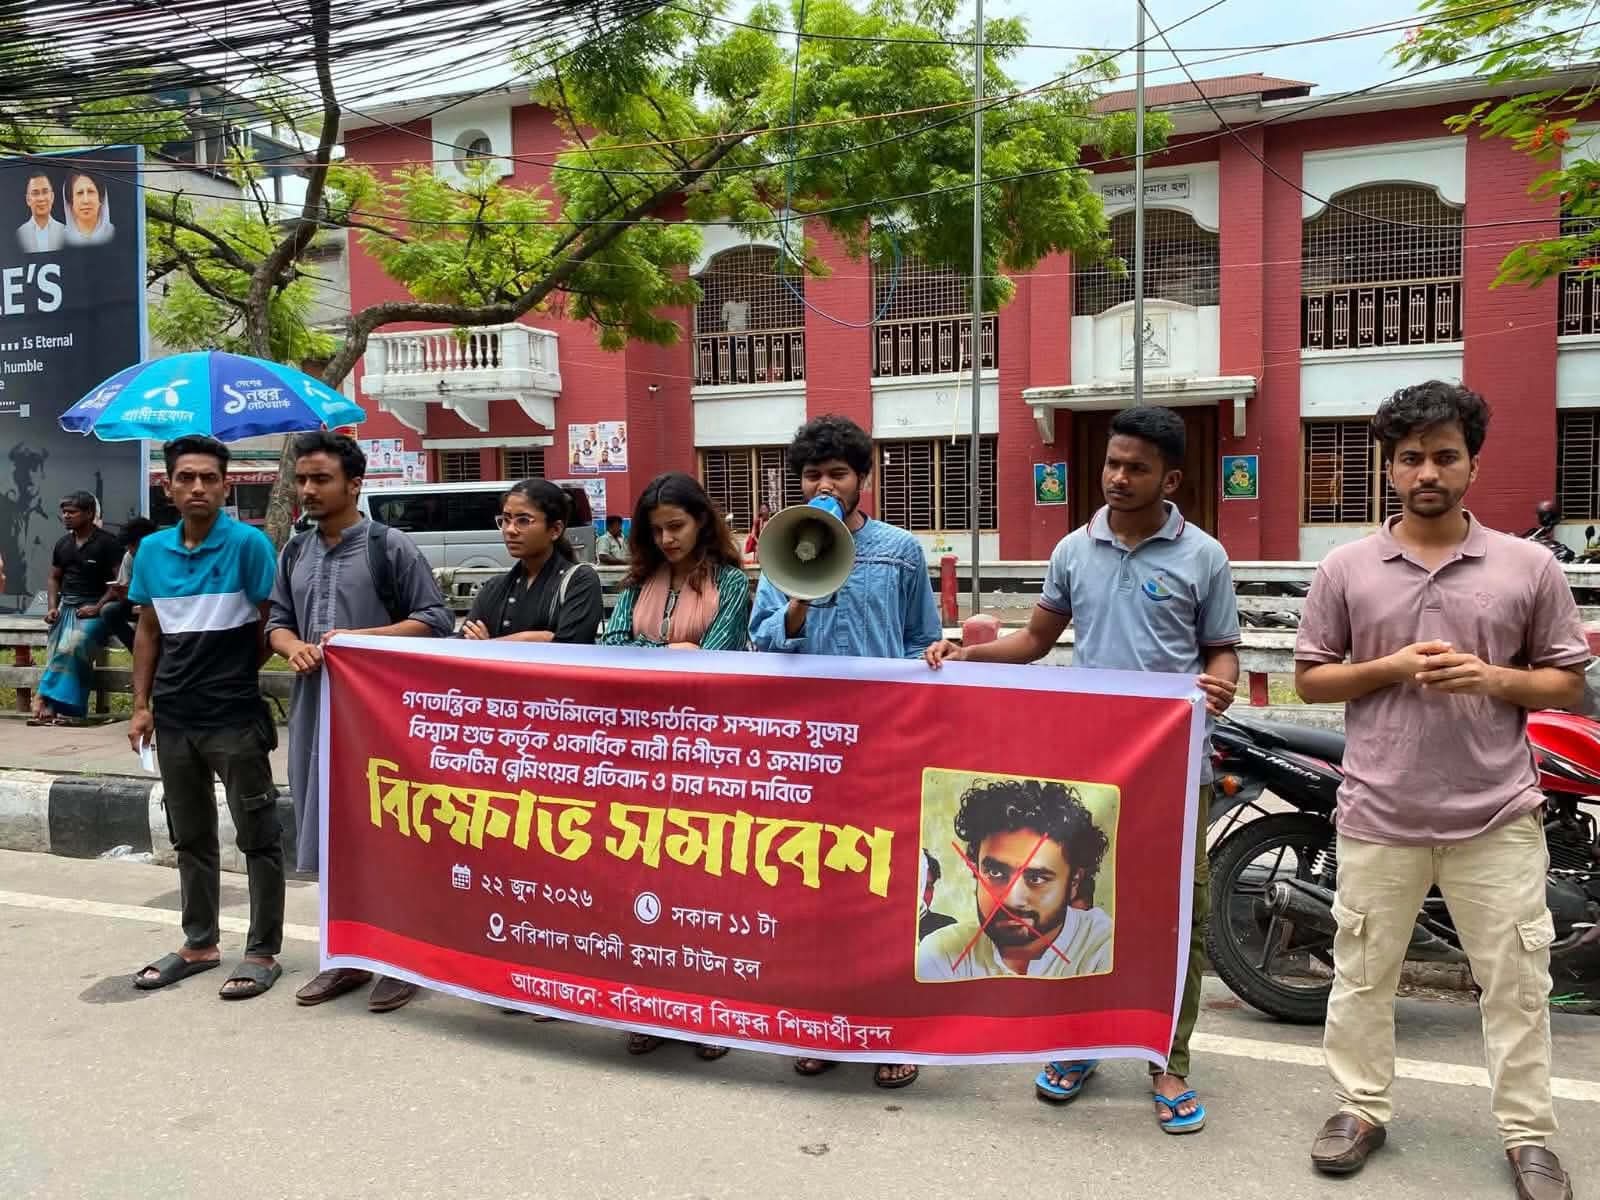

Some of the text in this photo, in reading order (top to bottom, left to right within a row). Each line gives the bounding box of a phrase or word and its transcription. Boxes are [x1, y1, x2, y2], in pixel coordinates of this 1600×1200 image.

[0, 263, 63, 315] E'S
[4, 359, 44, 374] humble
[22, 336, 33, 350] Is
[36, 333, 73, 348] Eternal
[223, 384, 246, 414] ১
[402, 689, 859, 748] গণতান্ত্রিক ছাত্র কাউন্সিলের সাংগঠনিক সম্পাদক সুজয়
[409, 715, 843, 774] বিশ্বাস শুভ কর্তৃক একাধিক নারী নিপীড়ন ও ক্রমাগত
[429, 745, 813, 804] ভিকটিম ব্লেমিংয়ের প্রতিবাদ ও চার দফা দাবিতে
[366, 757, 895, 898] বিক্ষোভ সমাবেশ
[481, 875, 593, 909] ২২ জুন ২০২৬
[671, 906, 778, 938] সকাল ১১ টা
[510, 921, 763, 981] বরিশাল অশ্বিনী কুমার টাউন হল
[511, 973, 894, 1049] আয়োজনে: বরিশালের বিক্ষুব্ধ শিক্ষার্থীবৃন্দ
